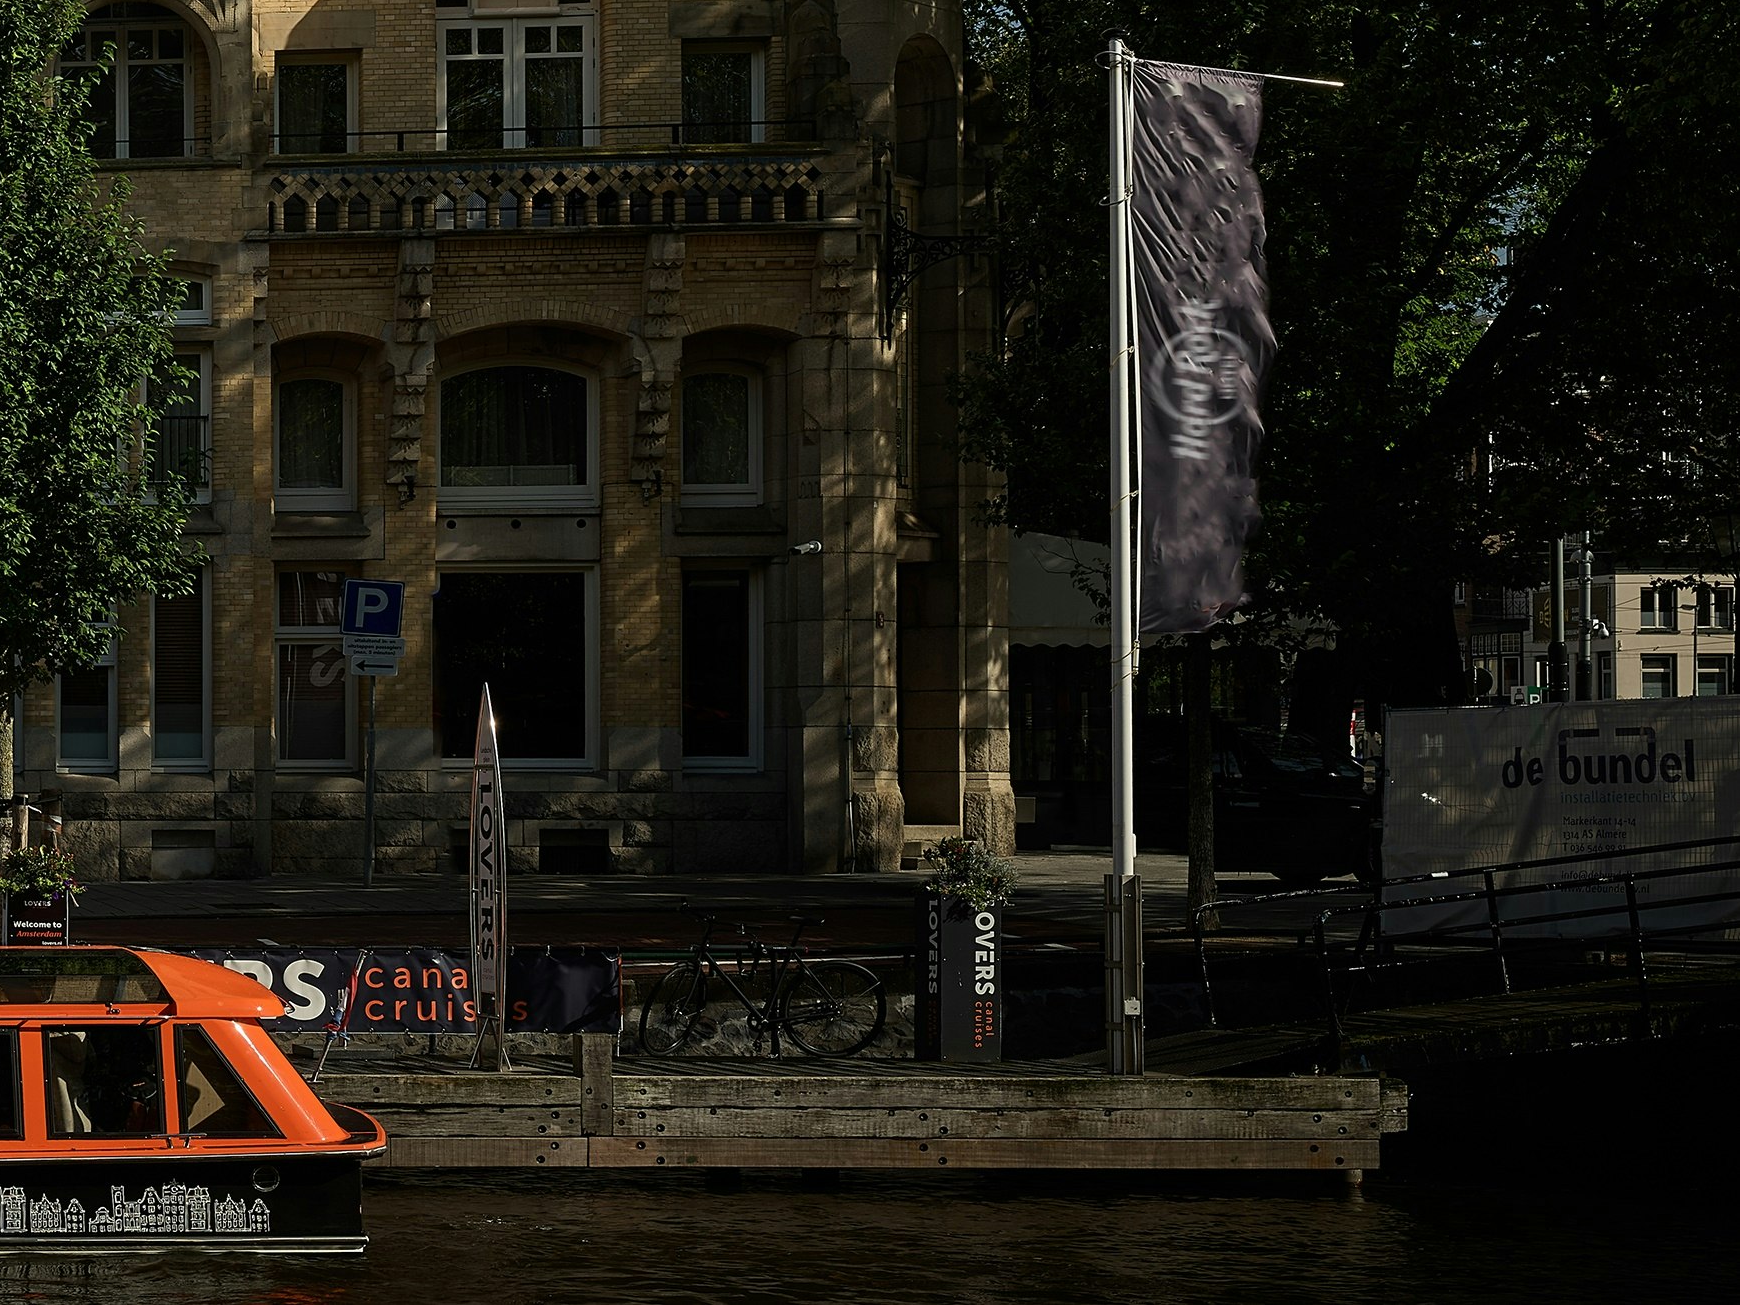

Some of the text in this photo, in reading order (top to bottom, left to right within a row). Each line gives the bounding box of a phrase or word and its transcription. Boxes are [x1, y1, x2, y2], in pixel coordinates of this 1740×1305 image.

[355, 587, 389, 628] P
[1502, 727, 1695, 788] de bundel
[1563, 816, 1611, 826] Markerkant
[1563, 830, 1627, 839] 1314 AS Almere
[478, 781, 494, 962] LOVERS
[928, 900, 938, 994] LOVERS
[975, 911, 995, 995] OVERS
[364, 964, 470, 990] cana
[364, 993, 529, 1023] cruiss
[974, 1000, 985, 1049] cruises
[985, 1001, 995, 1037] canal
